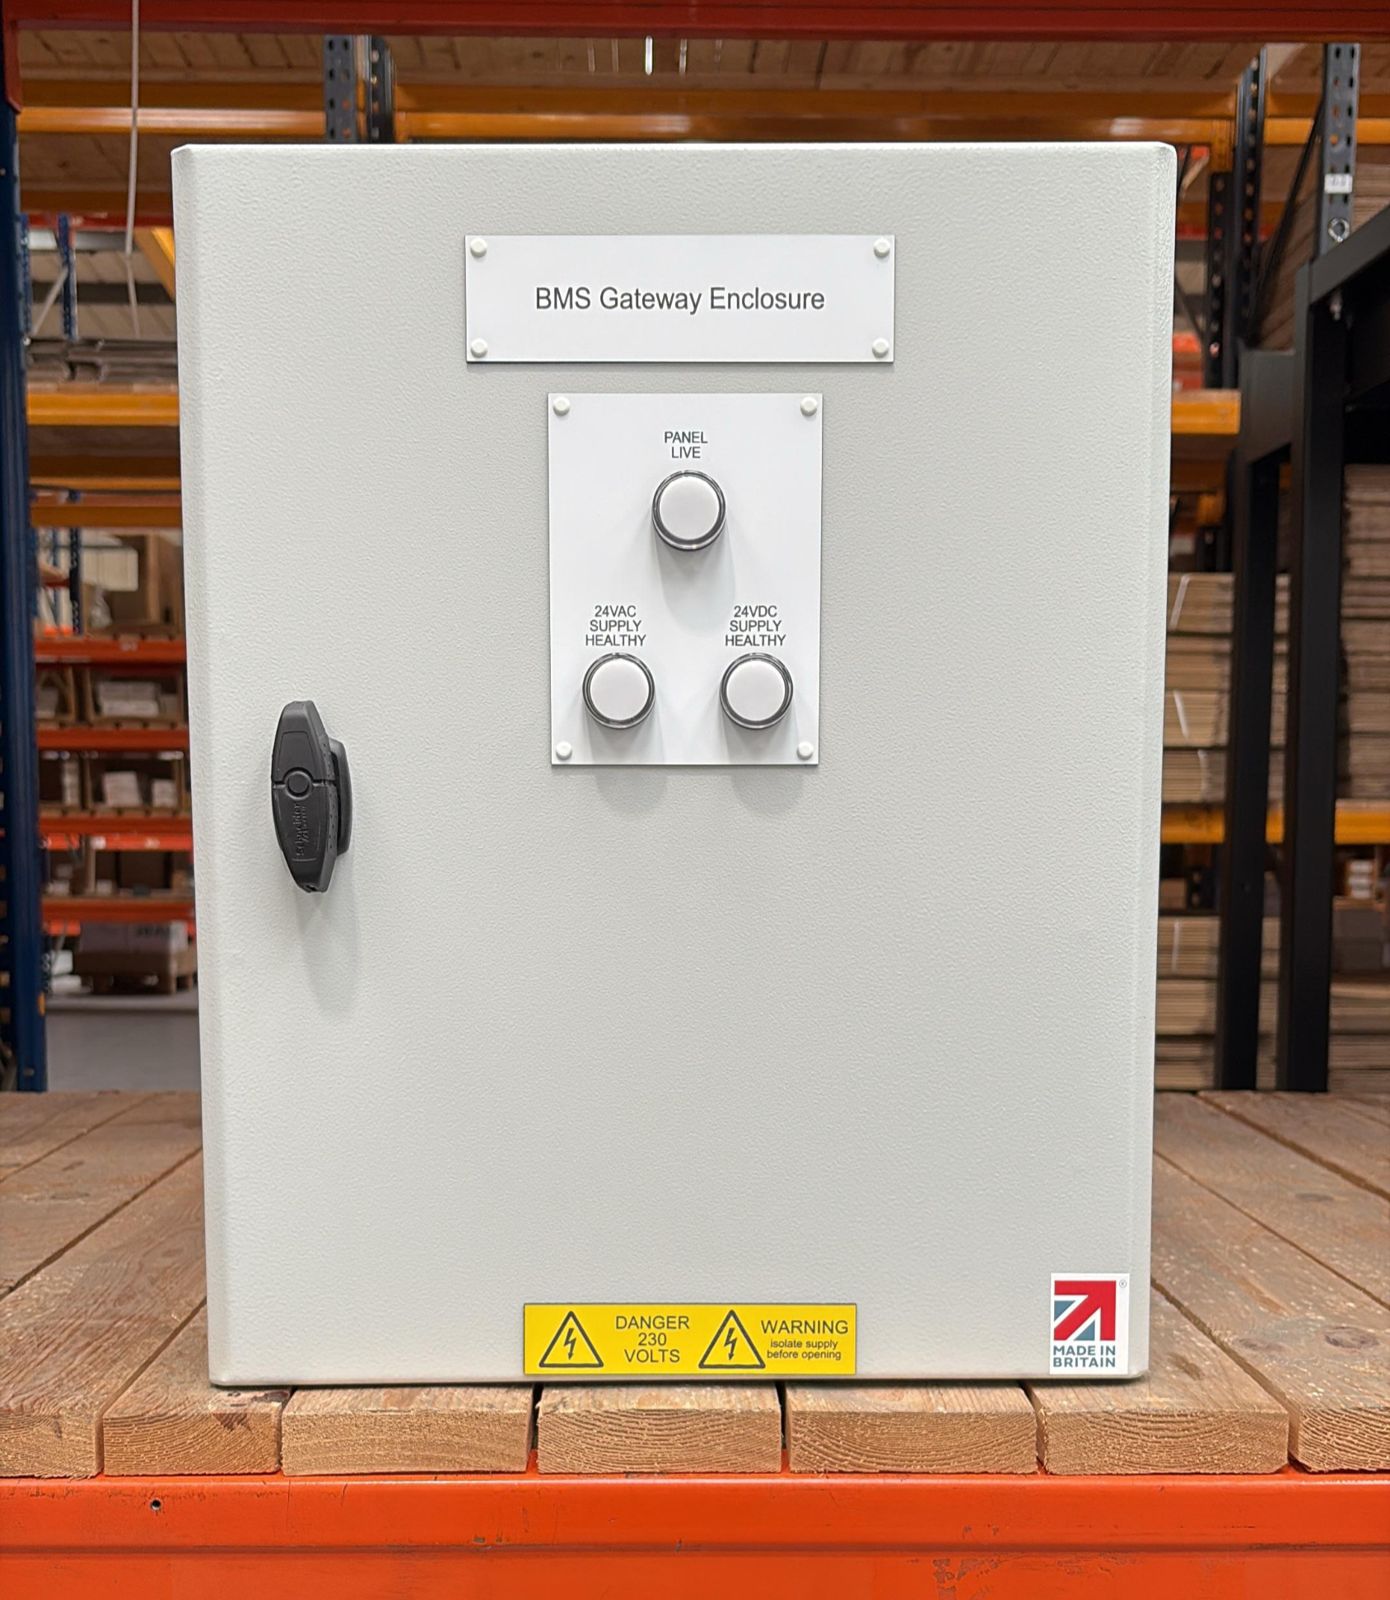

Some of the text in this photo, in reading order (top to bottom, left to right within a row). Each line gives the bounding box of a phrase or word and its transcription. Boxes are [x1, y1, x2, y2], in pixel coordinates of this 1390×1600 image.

[536, 286, 825, 316] BMS Gateway Enclosure
[664, 430, 709, 444] PANEL
[671, 446, 701, 459] LIVE
[594, 604, 637, 618] 24VAC
[733, 604, 778, 618] 24VDC
[589, 619, 642, 633] SUPPLY
[729, 619, 782, 633] SUPPLY
[585, 633, 647, 647] HEALTHY
[724, 634, 787, 647] HEALTHY
[615, 1315, 690, 1330] DANGER
[760, 1319, 849, 1335] WARNING
[637, 1332, 667, 1347] 230
[770, 1338, 838, 1351] isolate supply
[623, 1348, 681, 1364] VOLTS
[766, 1349, 842, 1361] before opening
[1052, 1345, 1116, 1356] MADE IN
[1052, 1356, 1116, 1368] BRITAIN
